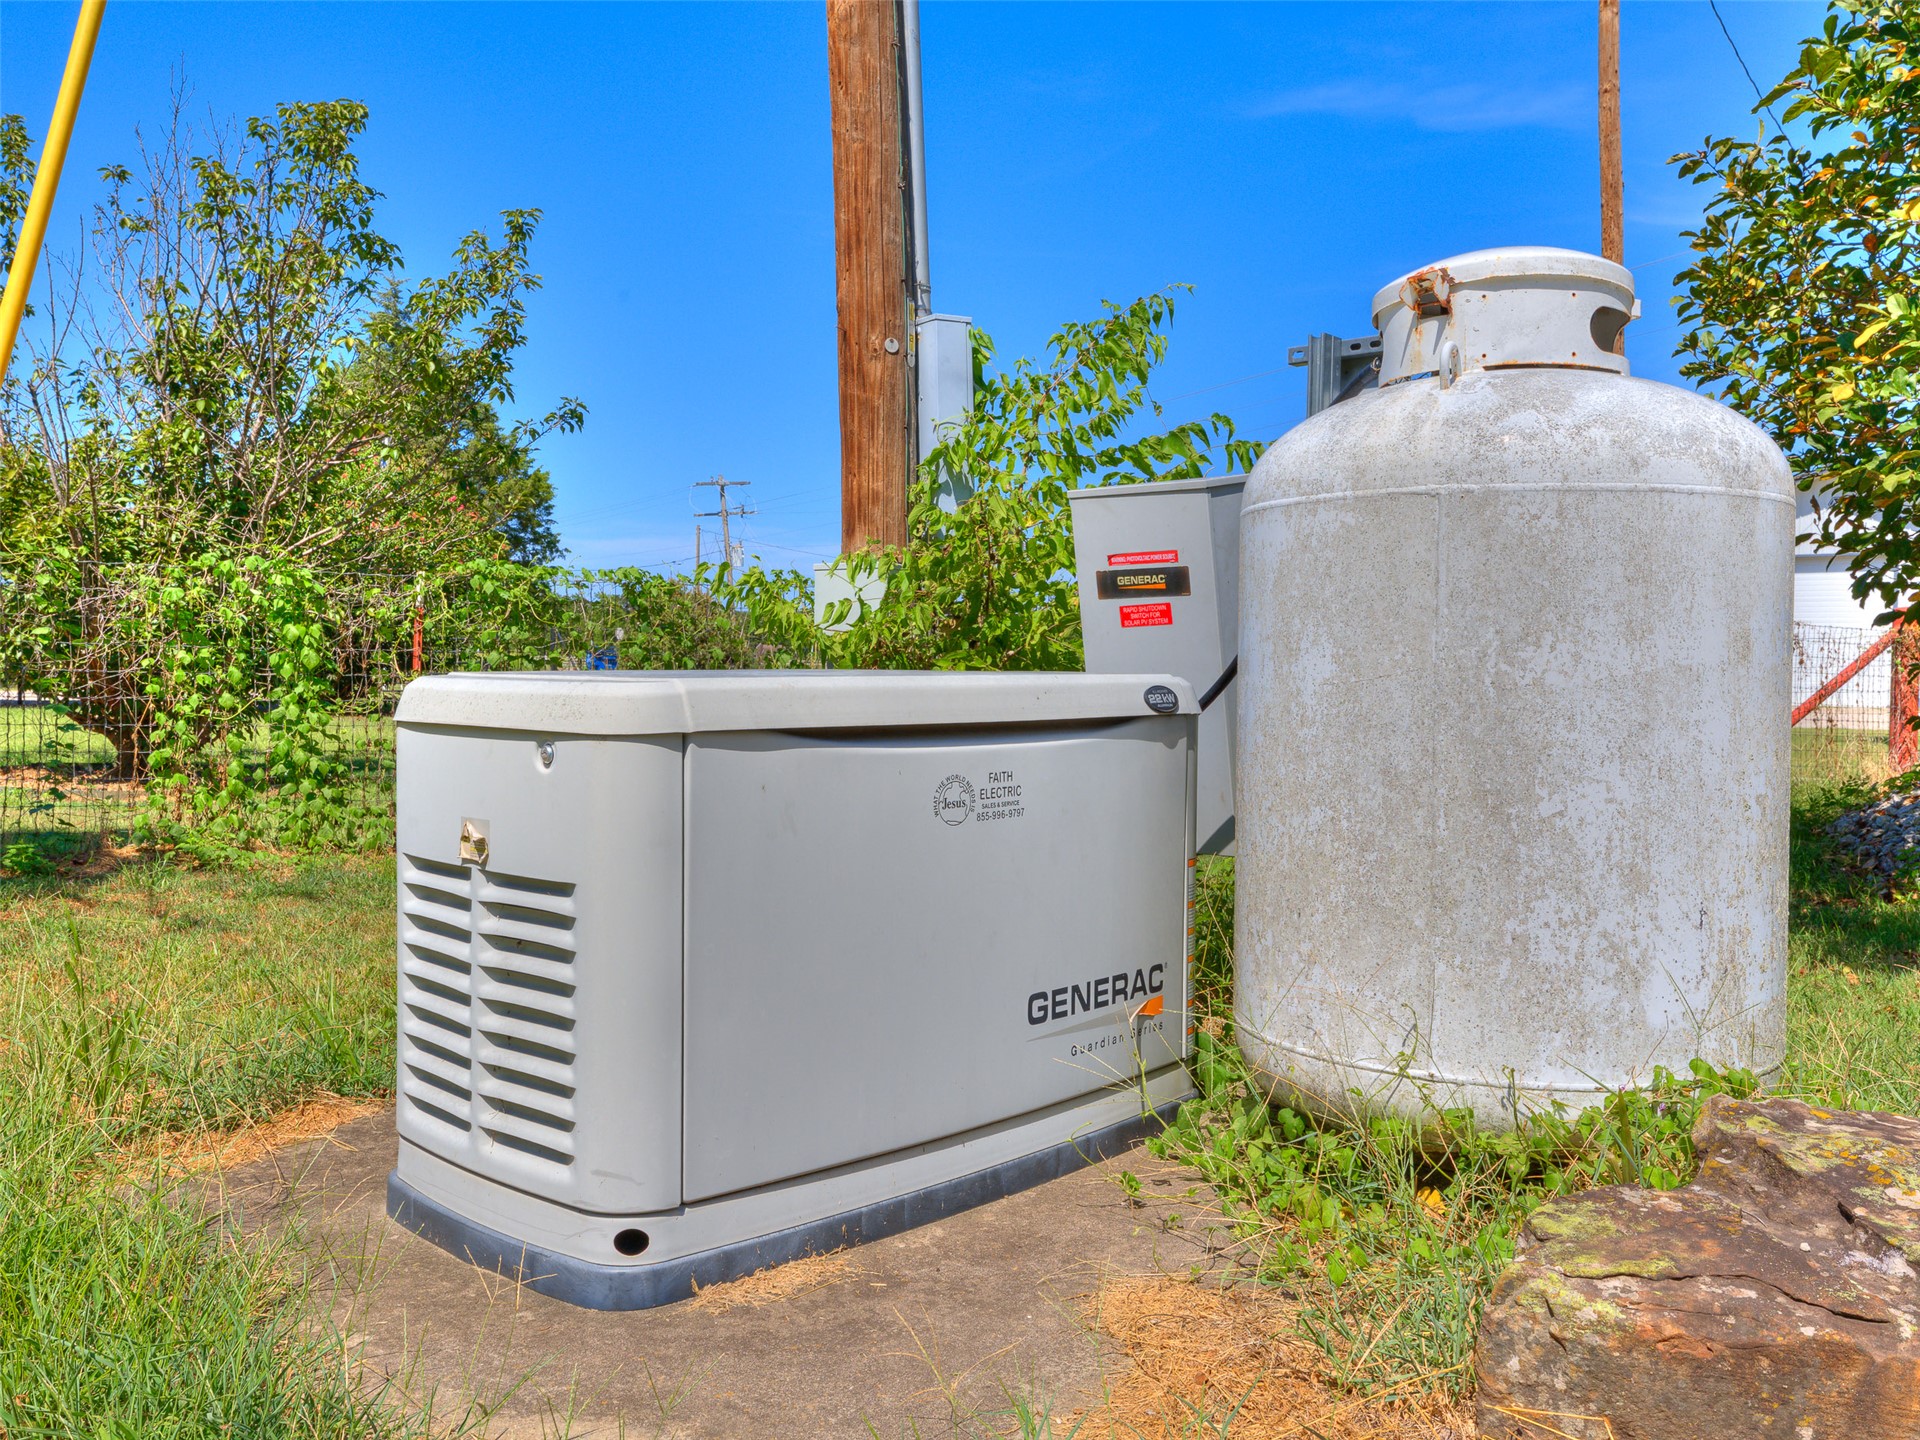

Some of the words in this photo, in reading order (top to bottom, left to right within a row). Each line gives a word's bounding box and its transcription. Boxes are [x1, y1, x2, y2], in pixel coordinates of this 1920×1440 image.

[1117, 574, 1166, 586] GENERAC
[936, 780, 946, 794] THE
[945, 774, 966, 782] WORLD
[988, 771, 1013, 784] FAITH
[980, 785, 1022, 800] ELECTRIC
[942, 798, 966, 810] Jesus
[976, 808, 1025, 822] 855-996-9797
[1027, 963, 1164, 1026] GENERAC
[1070, 1034, 1124, 1056] Guardian
